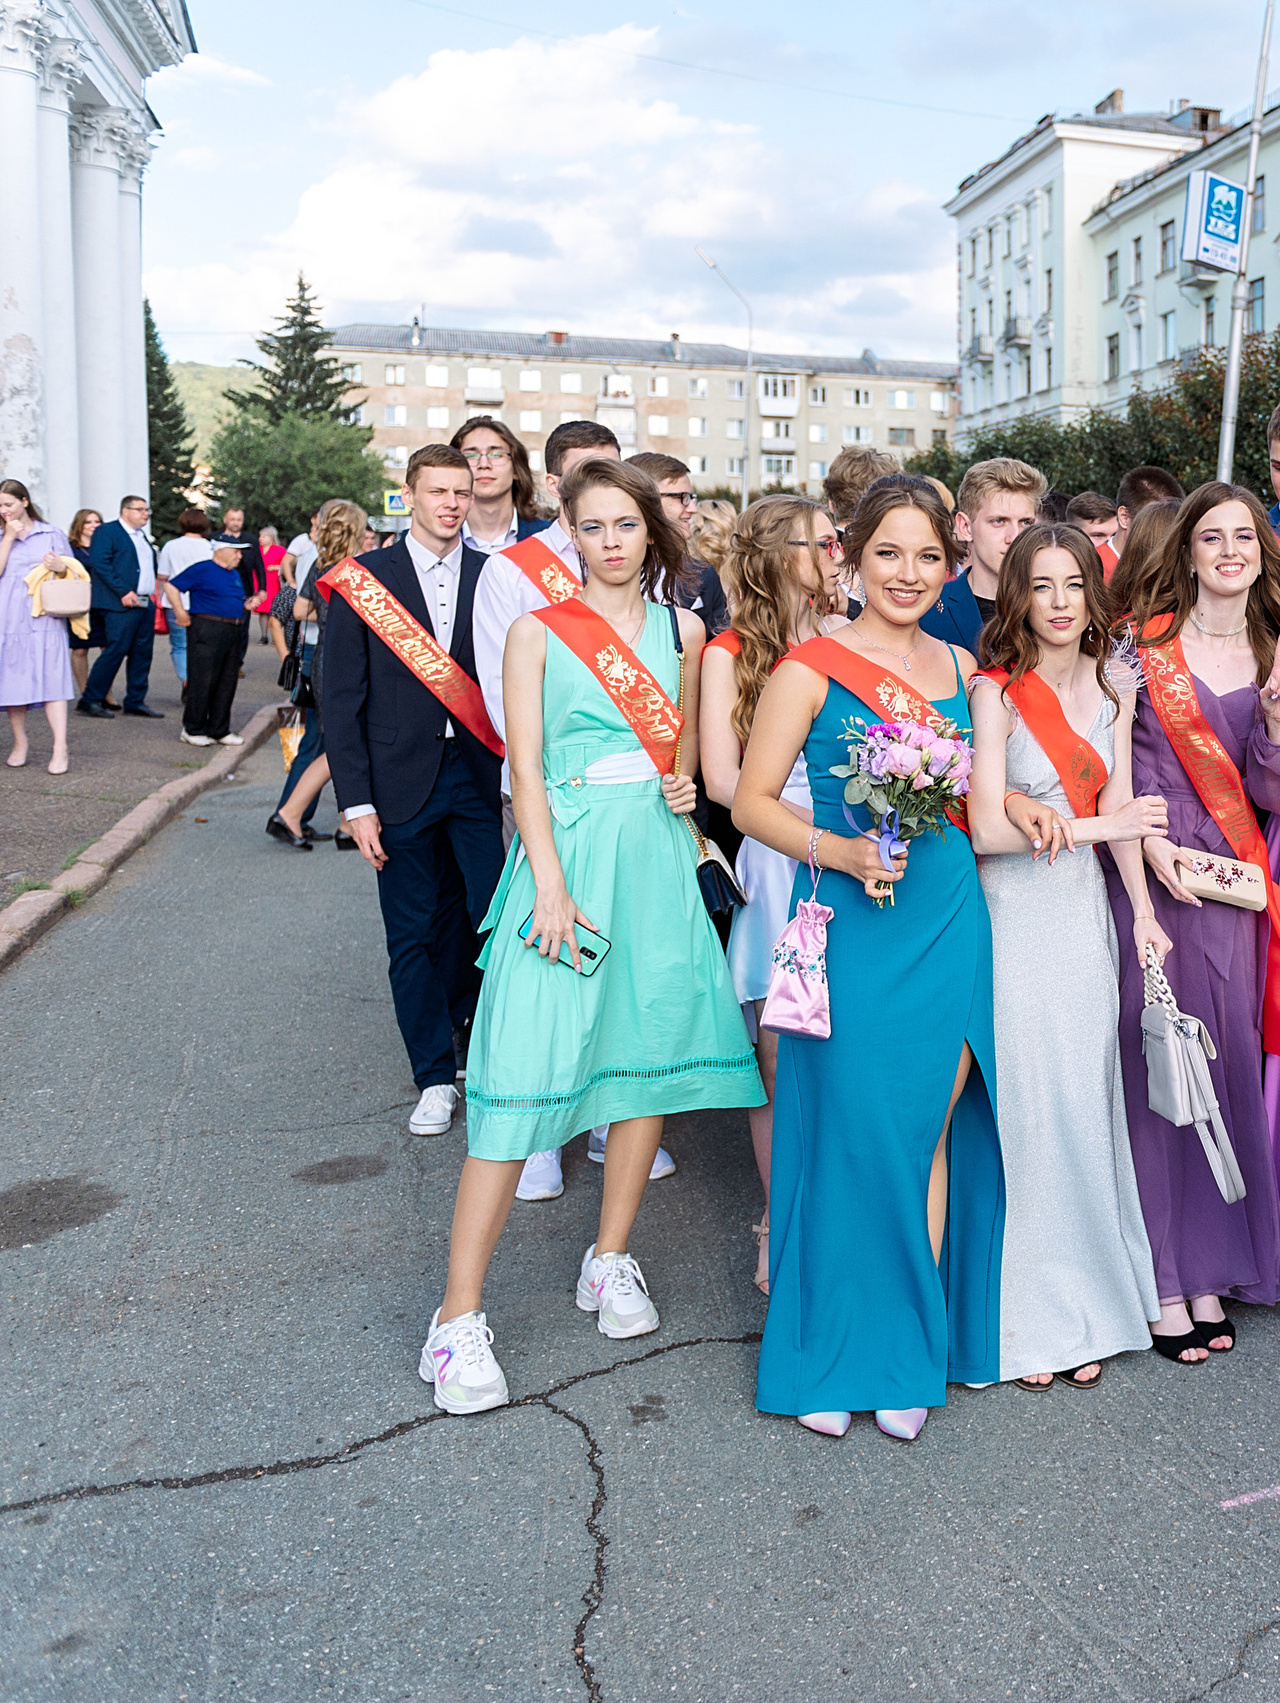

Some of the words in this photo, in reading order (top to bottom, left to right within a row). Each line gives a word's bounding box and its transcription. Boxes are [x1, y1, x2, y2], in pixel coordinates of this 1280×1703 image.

[350, 580, 445, 676] Выпускник
[1156, 669, 1240, 806] Выпускник
[1216, 798, 1257, 843] 2022
